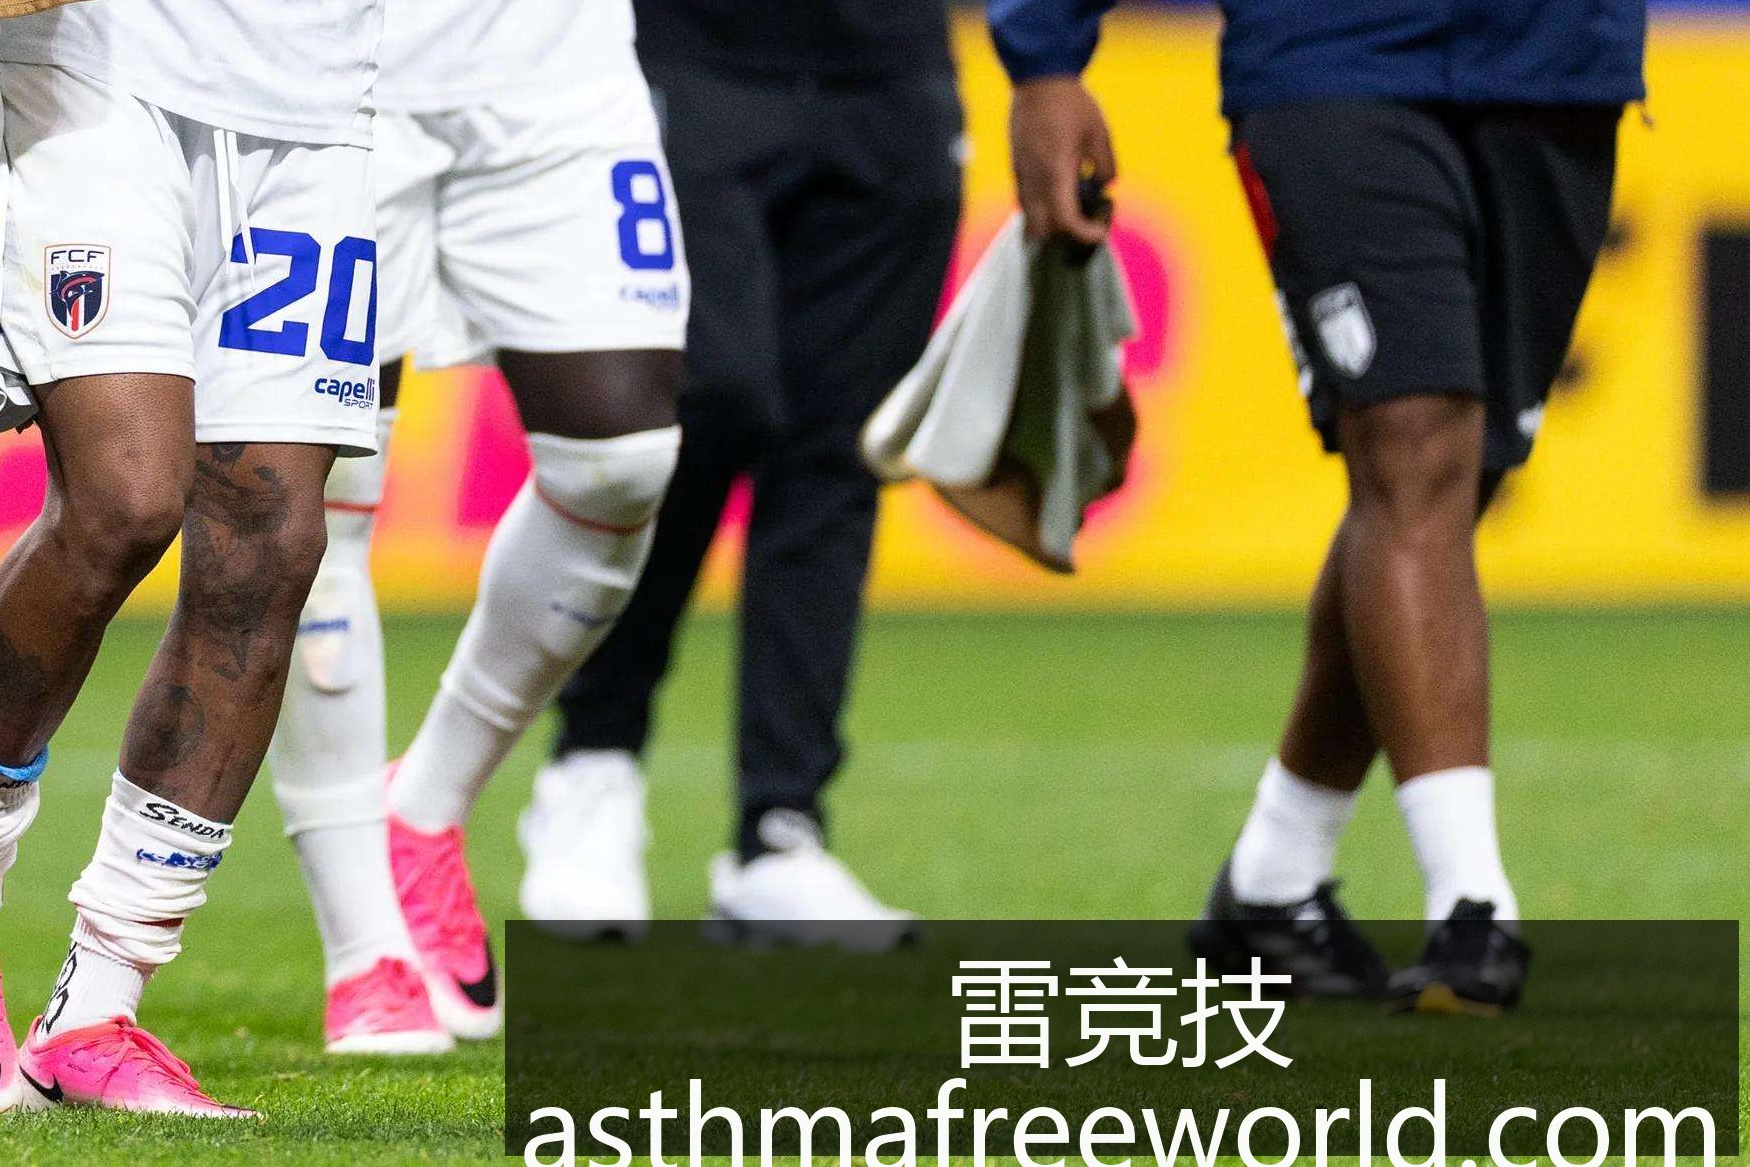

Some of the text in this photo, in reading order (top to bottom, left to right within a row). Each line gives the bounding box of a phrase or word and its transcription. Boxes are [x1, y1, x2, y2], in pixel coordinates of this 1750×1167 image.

[611, 160, 674, 271] 8
[50, 249, 105, 265] FCF
[218, 227, 378, 366] 20
[314, 377, 376, 403] capelli
[344, 398, 374, 410] SPORT
